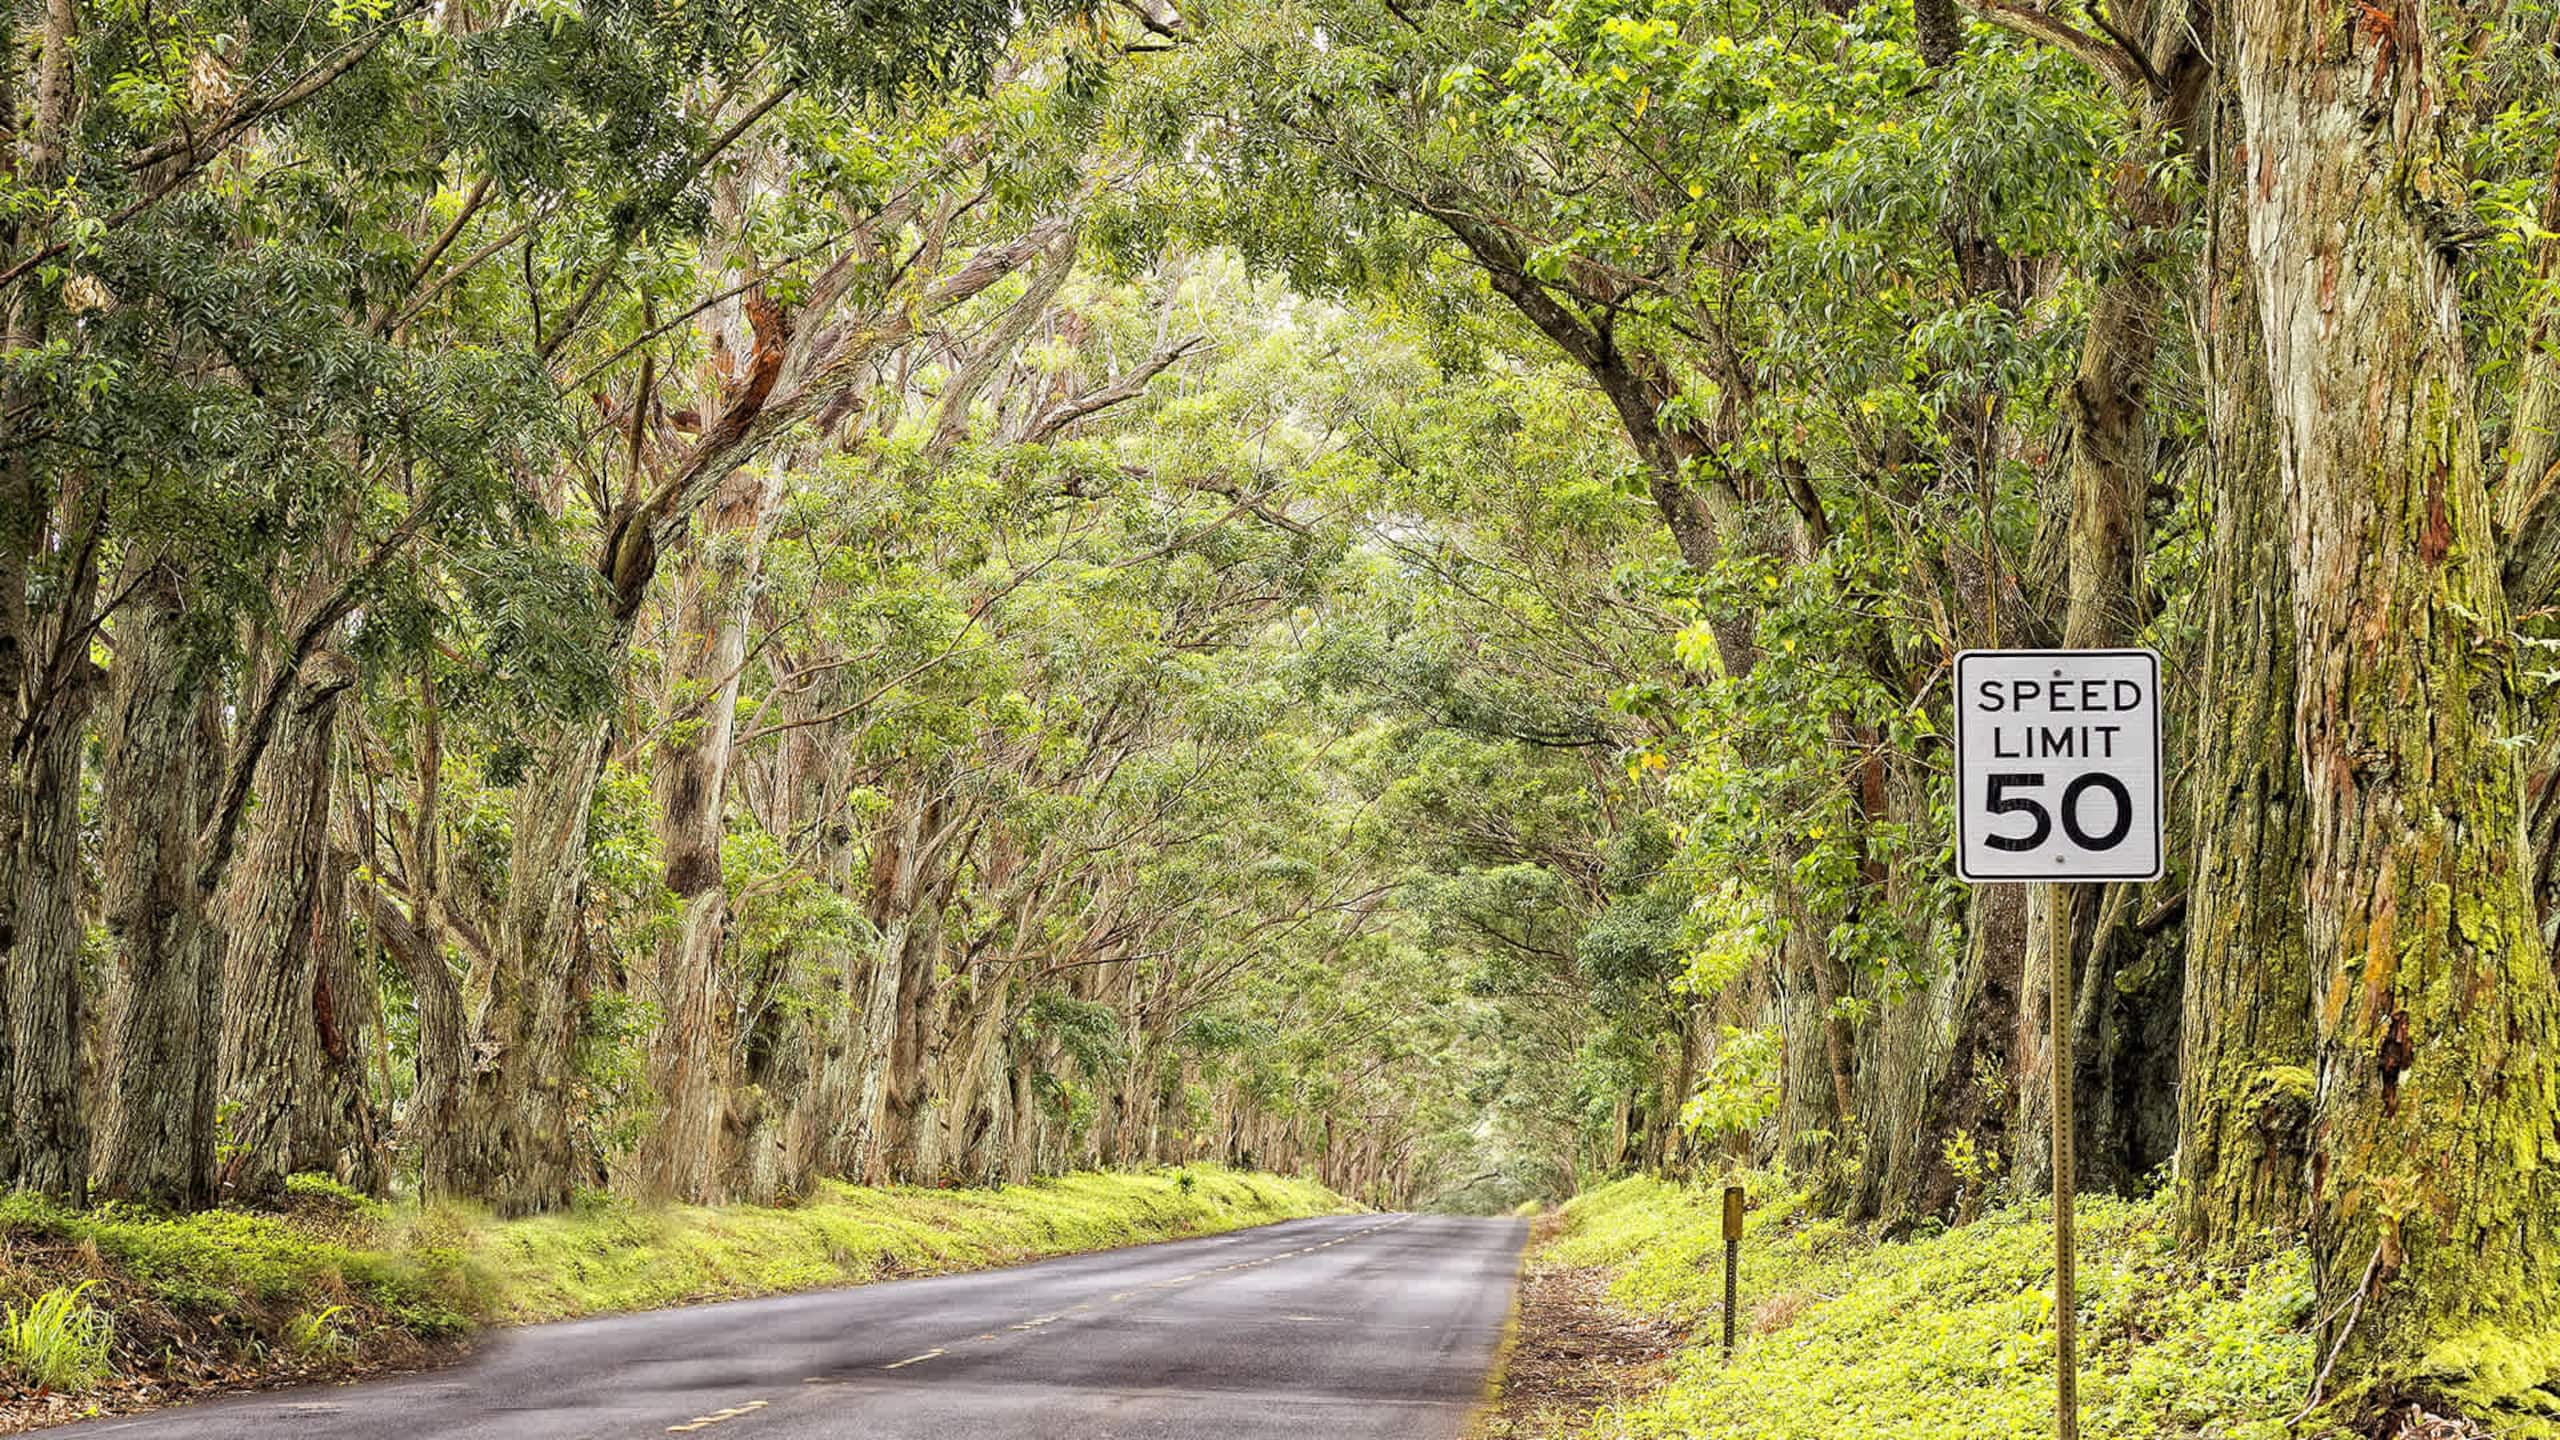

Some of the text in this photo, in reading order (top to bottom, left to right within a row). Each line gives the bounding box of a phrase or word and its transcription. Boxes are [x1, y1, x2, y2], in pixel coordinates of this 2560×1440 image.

[1978, 680, 2142, 712] SPEED
[1994, 726, 2121, 758] LIMIT
[1984, 772, 2133, 852] 50
